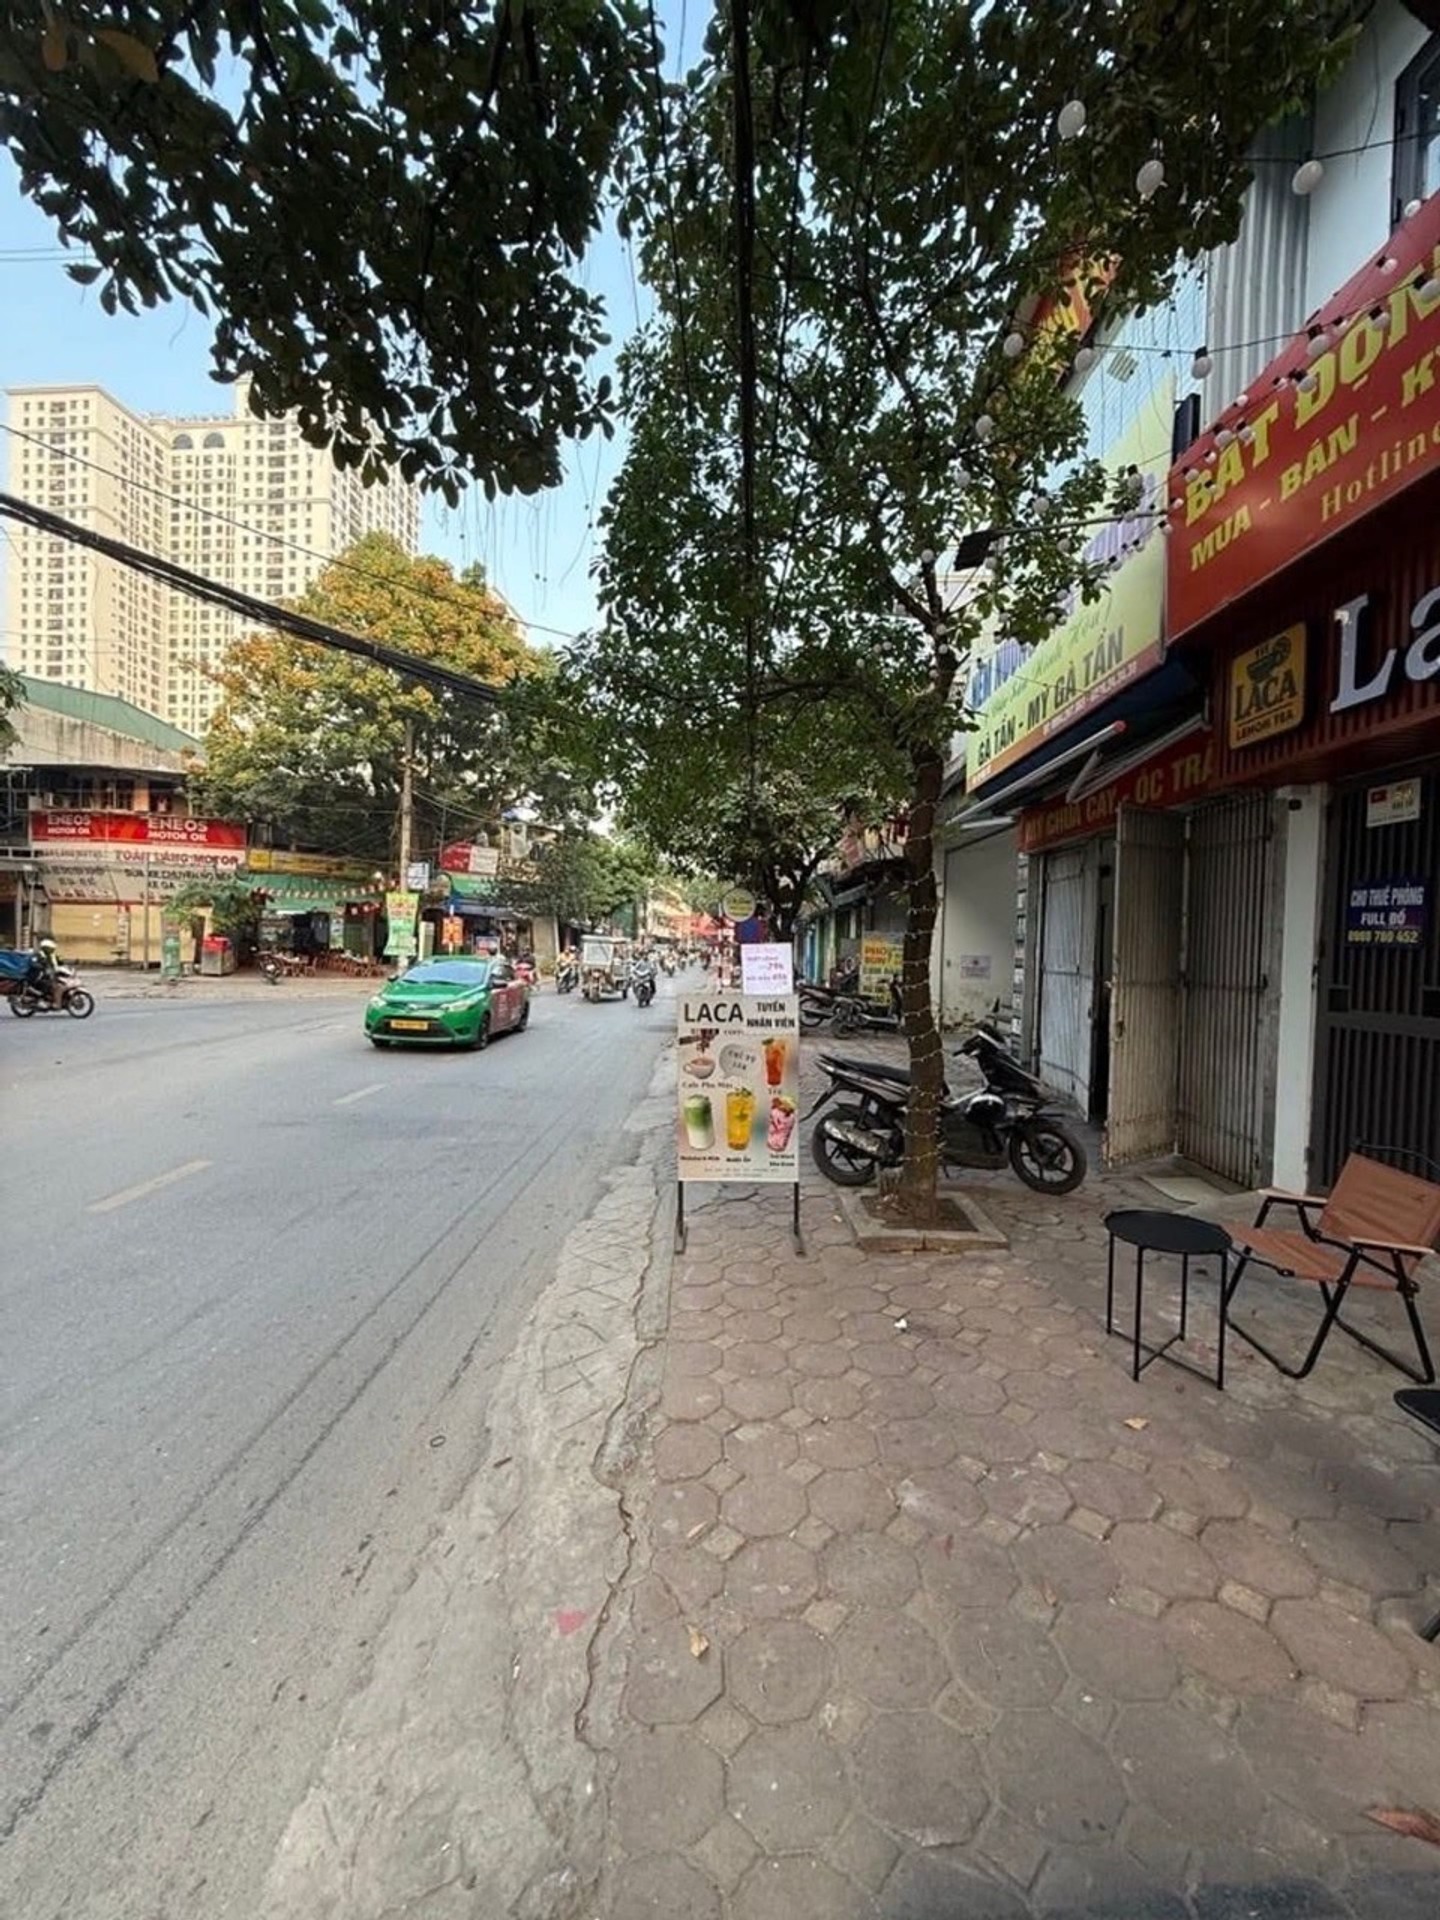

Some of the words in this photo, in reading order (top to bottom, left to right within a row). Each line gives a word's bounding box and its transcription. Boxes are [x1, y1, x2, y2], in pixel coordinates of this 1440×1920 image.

[1190, 505, 1251, 571] MUA
[1280, 413, 1360, 502] BÁN
[1234, 668, 1298, 722] LACA
[47, 814, 91, 826] ENEOS
[148, 817, 208, 832] ENEOS
[148, 831, 188, 841] MOTOR
[191, 833, 208, 842] OIL
[1360, 911, 1385, 926] FULL
[684, 1003, 743, 1022] LACA
